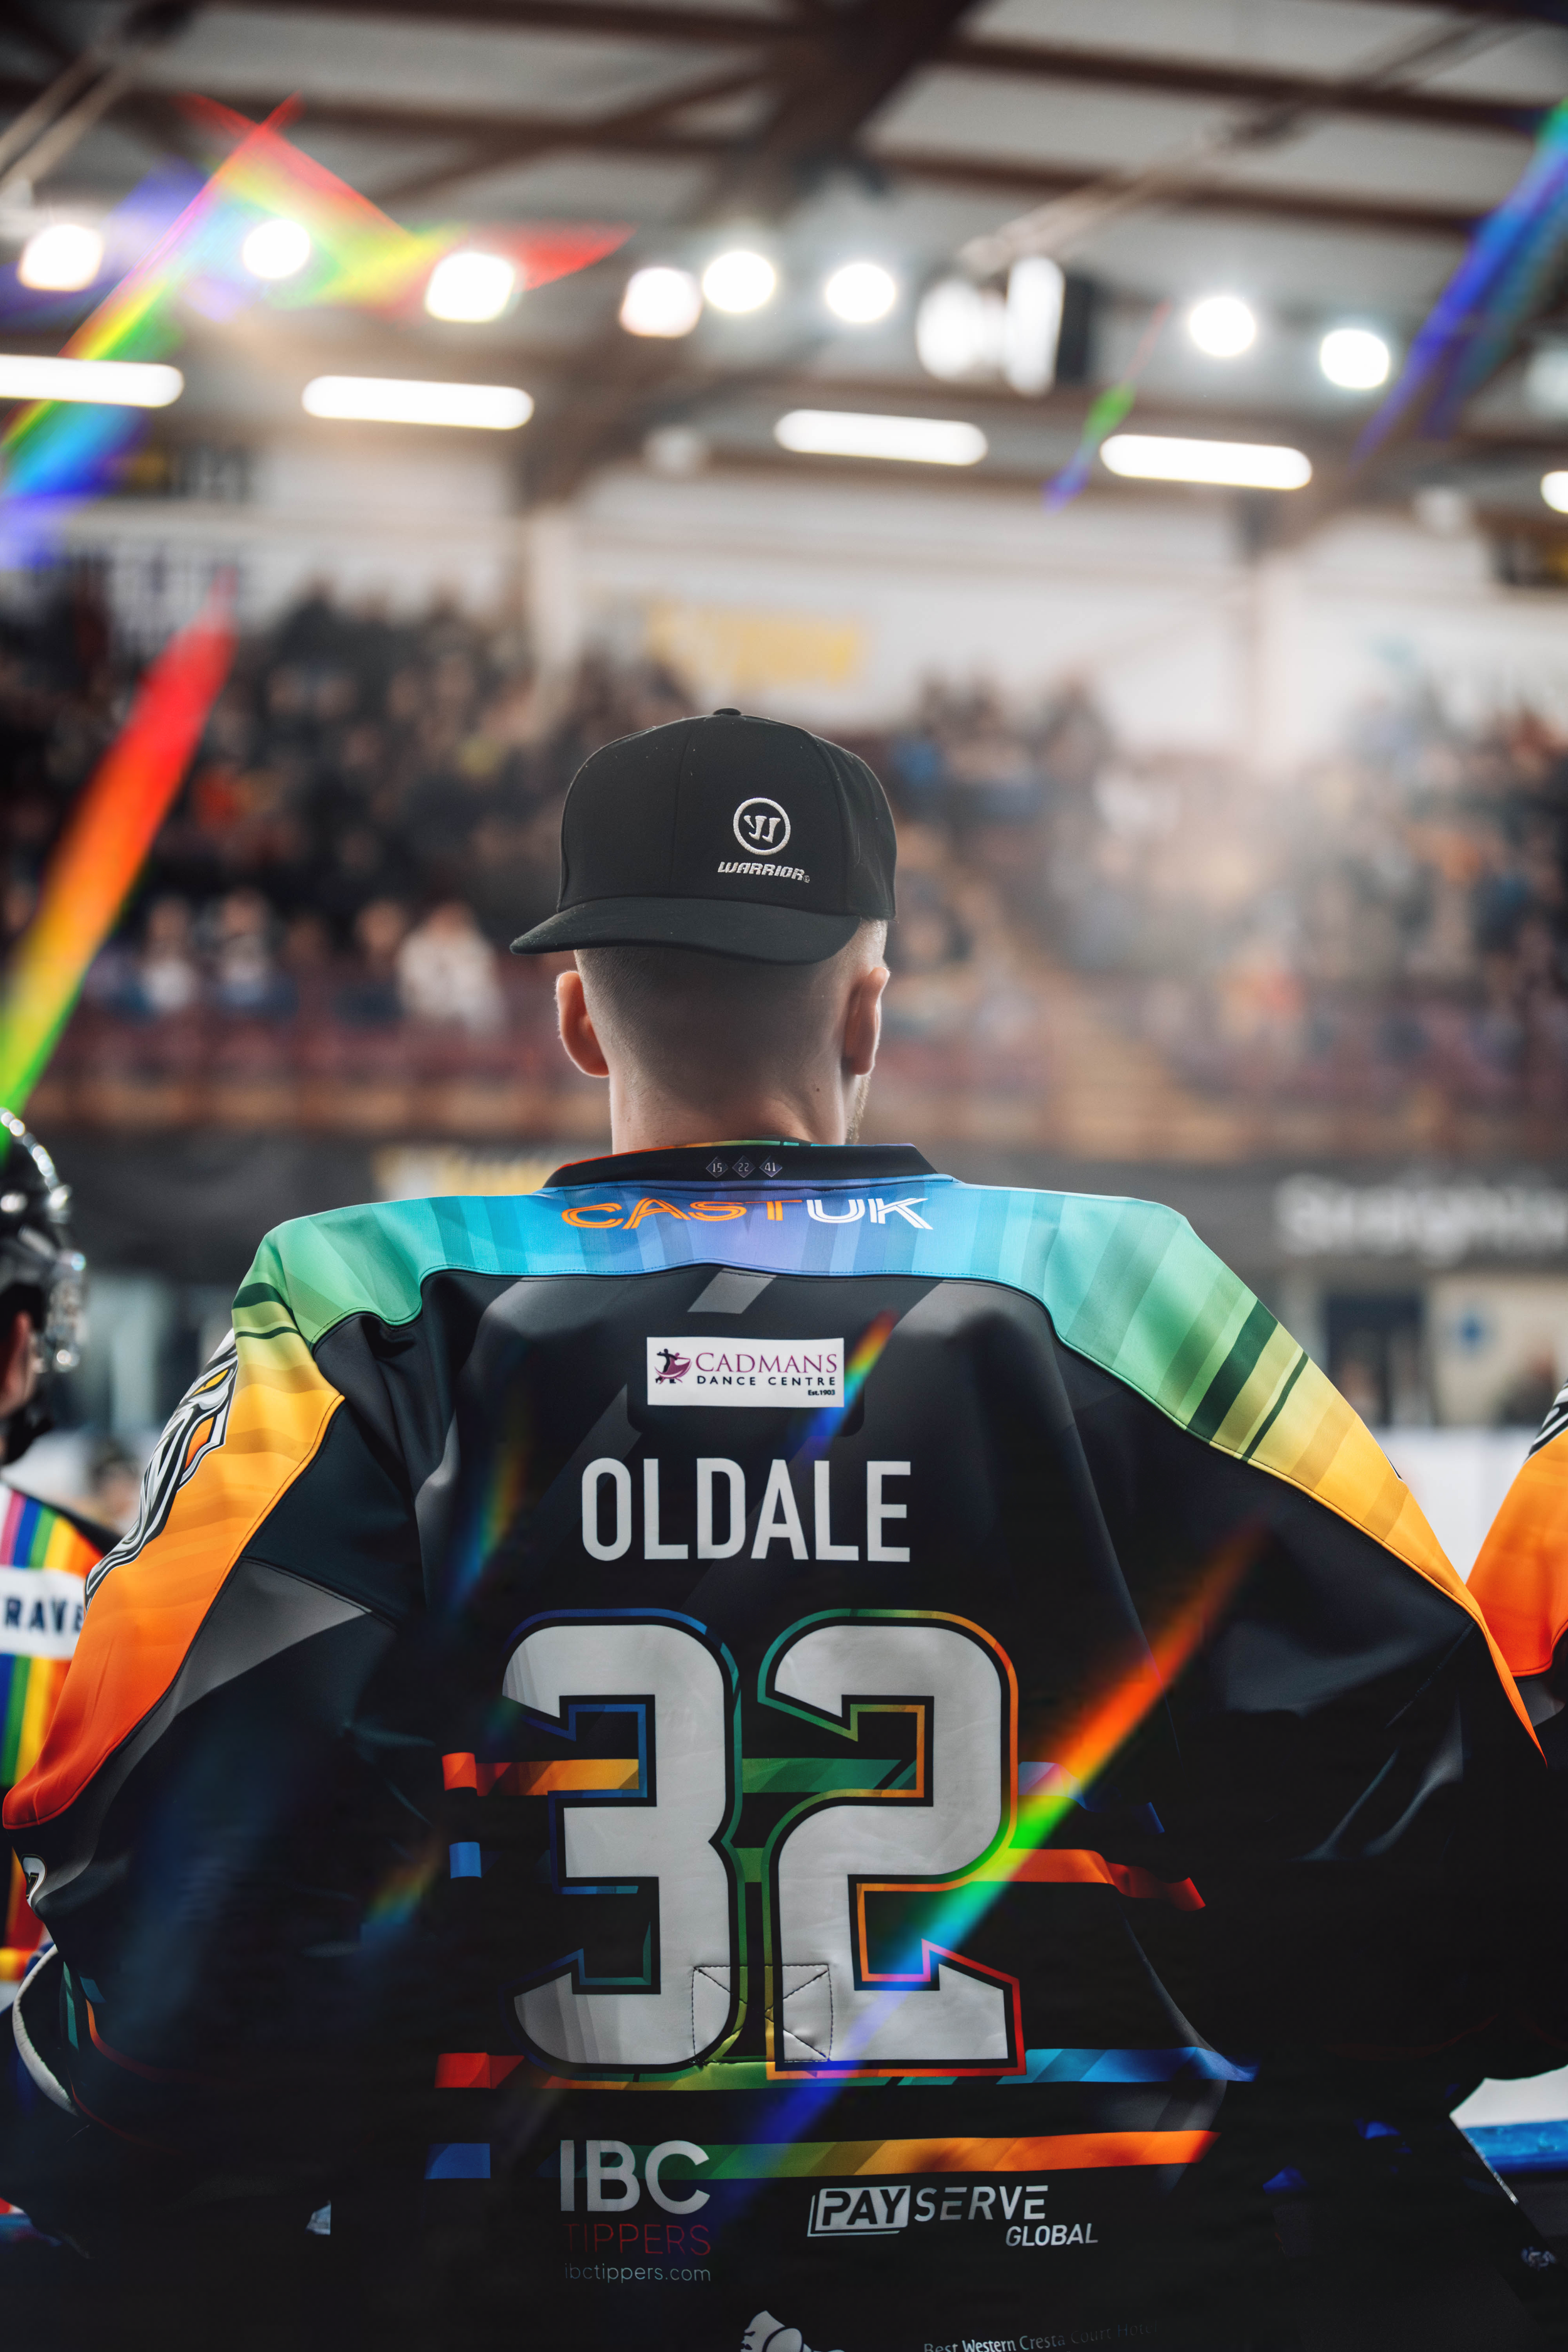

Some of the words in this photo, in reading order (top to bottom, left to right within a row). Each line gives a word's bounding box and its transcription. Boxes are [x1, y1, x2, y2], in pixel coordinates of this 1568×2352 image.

[712, 1163, 723, 1172] 15
[738, 1162, 750, 1172] 22
[765, 1162, 776, 1172] 41
[696, 1352, 838, 1374] CADMANS
[697, 1375, 756, 1386] DANCE
[768, 1376, 835, 1386] CENTRE
[581, 1457, 911, 1562] OLDALE
[502, 1609, 1026, 2077] 32
[560, 2139, 711, 2215] IBC
[562, 2223, 711, 2256] TIPPERS
[1005, 2223, 1099, 2247] GLOBAL
[564, 2263, 711, 2284] ibctippers.com
[961, 2339, 1017, 2352] Western
[1019, 2334, 1066, 2351] Cresta
[1070, 2329, 1112, 2344] Court
